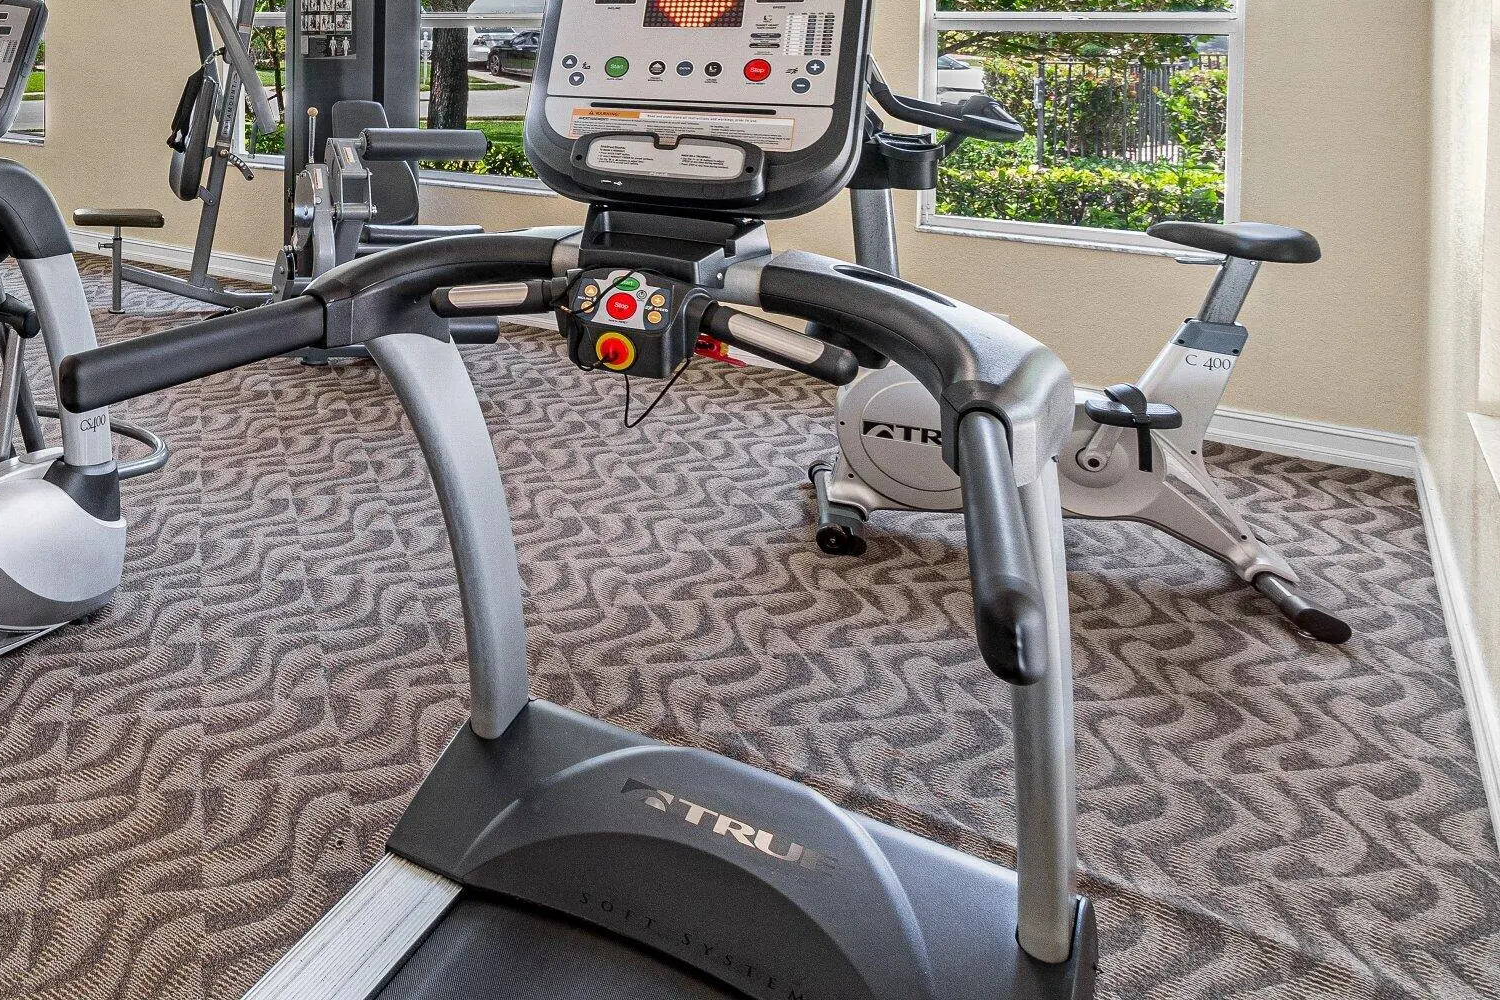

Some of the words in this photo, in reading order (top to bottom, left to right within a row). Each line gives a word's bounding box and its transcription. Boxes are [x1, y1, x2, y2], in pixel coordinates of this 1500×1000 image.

[614, 301, 629, 309] Stop
[1185, 354, 1198, 366] C
[1203, 357, 1231, 371] 400
[80, 414, 106, 432] CS400
[896, 424, 942, 446] TR
[580, 892, 656, 929] SOFT
